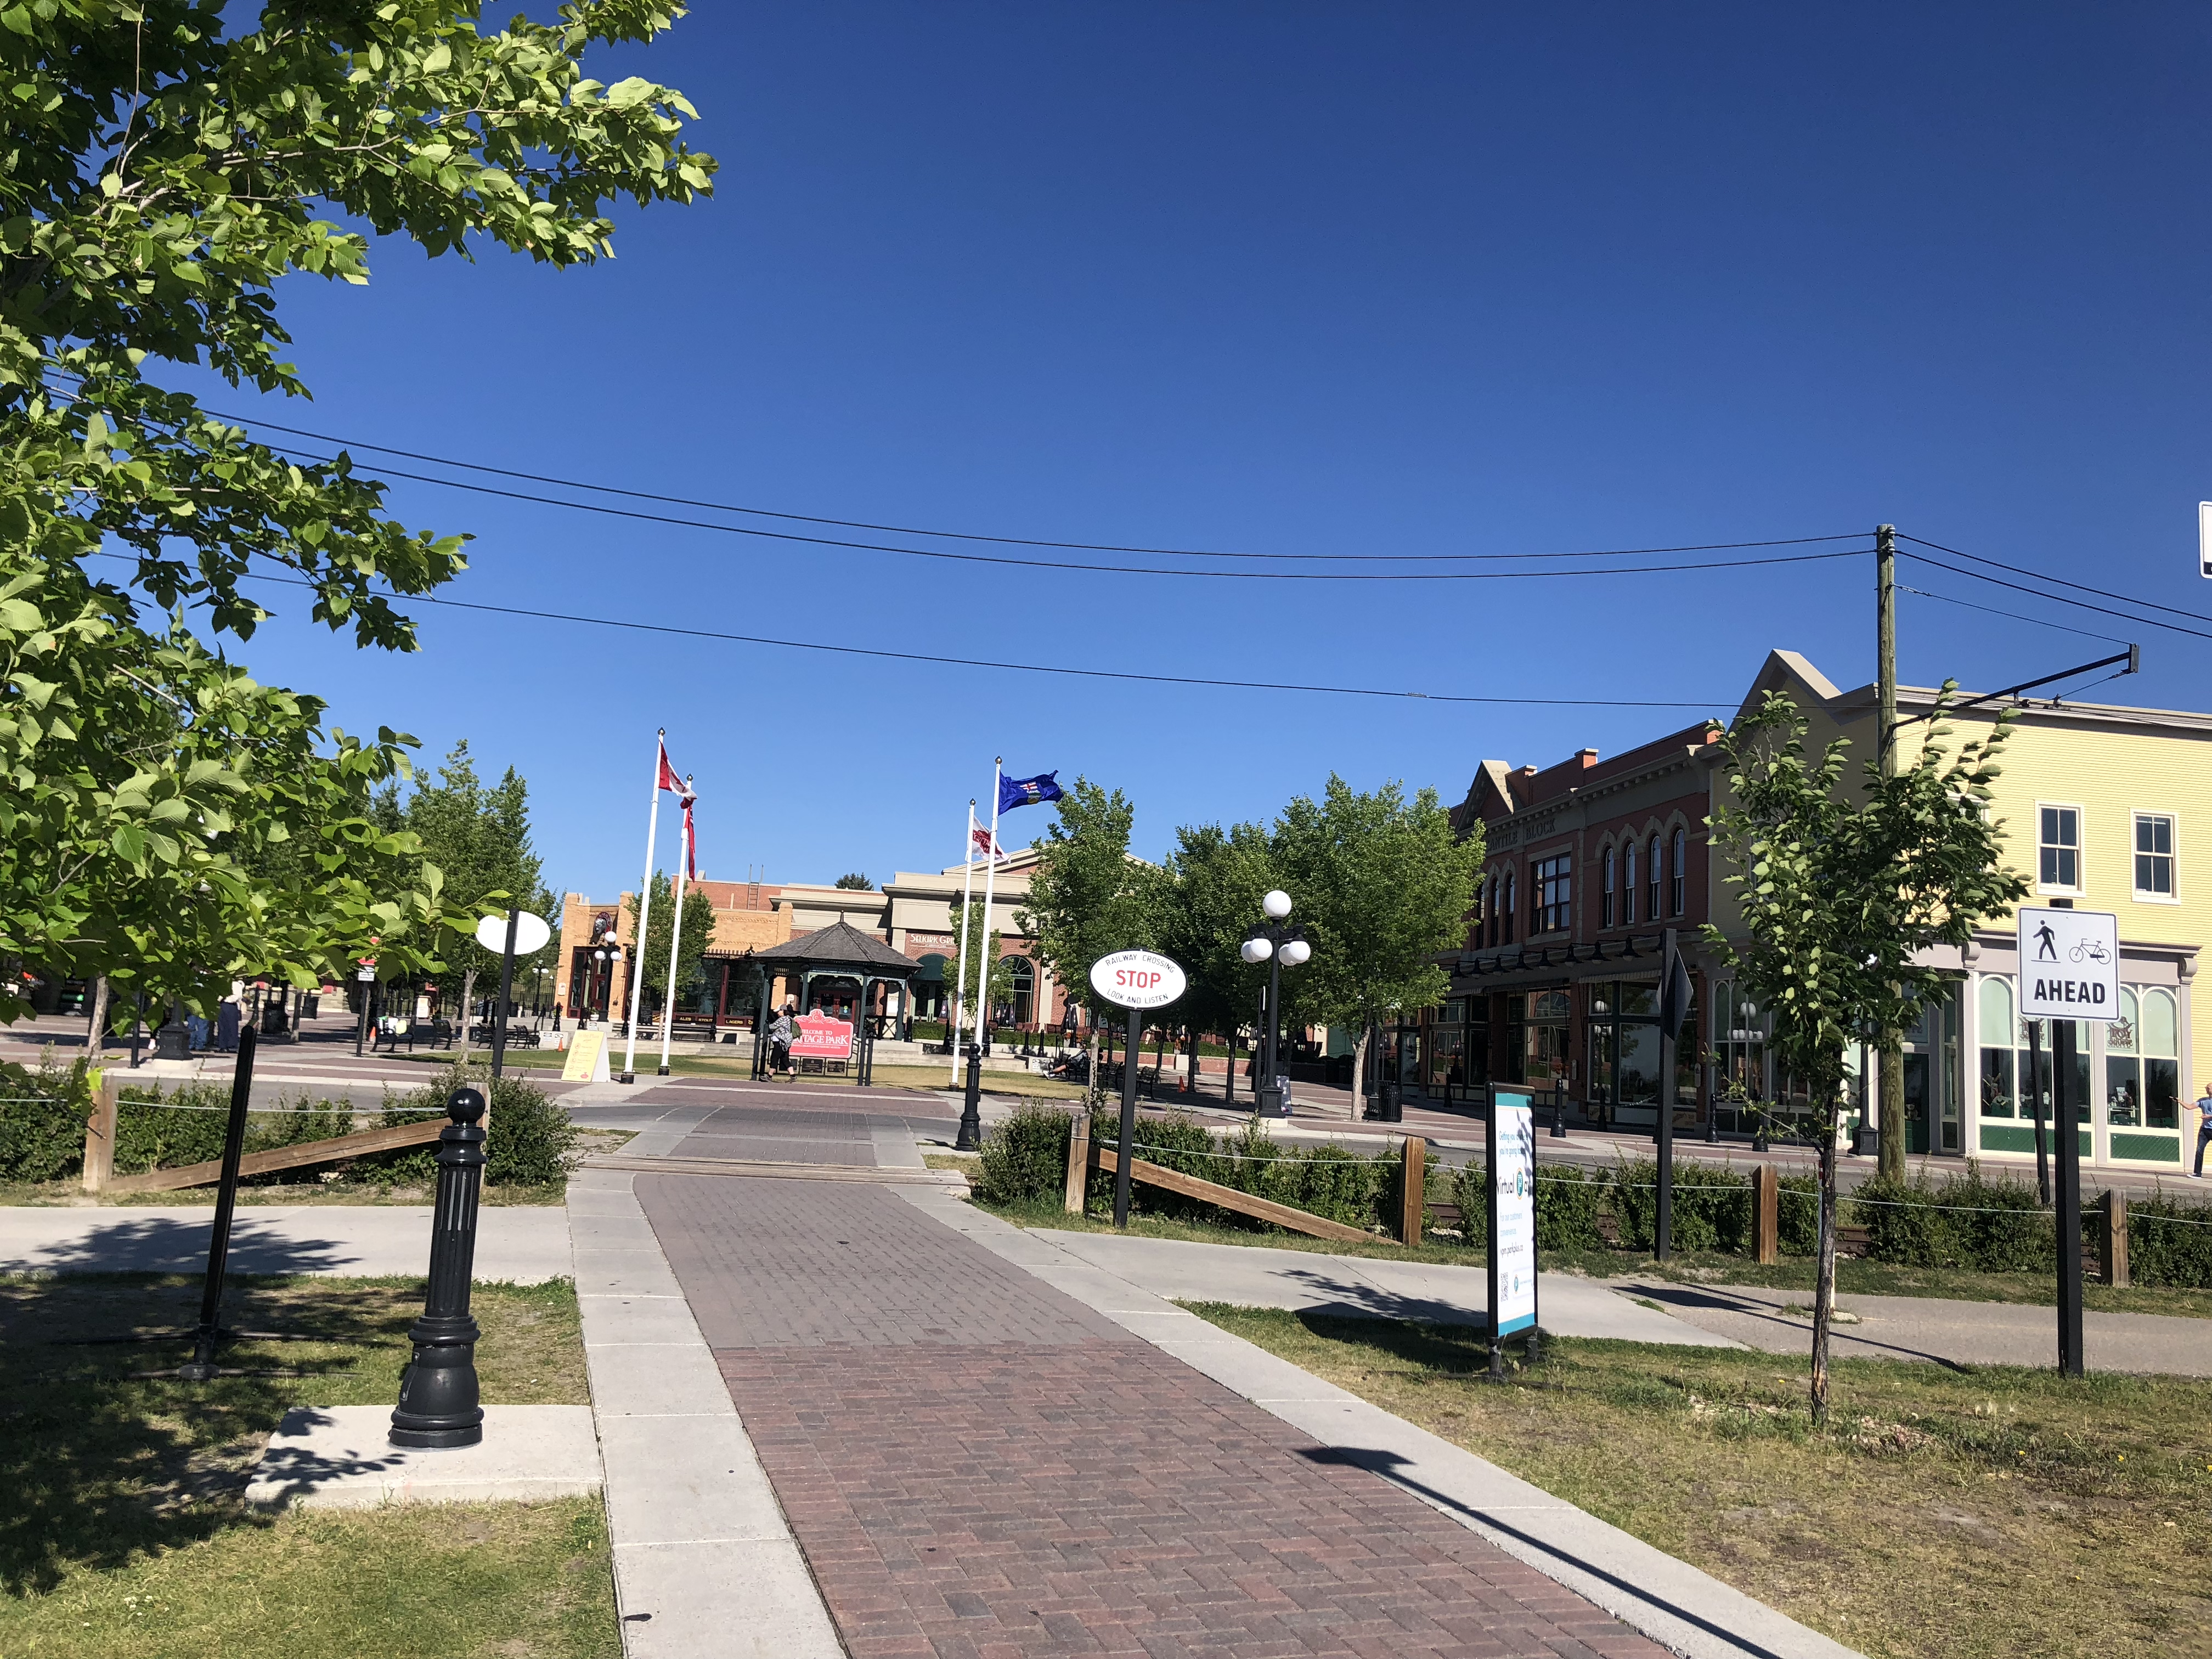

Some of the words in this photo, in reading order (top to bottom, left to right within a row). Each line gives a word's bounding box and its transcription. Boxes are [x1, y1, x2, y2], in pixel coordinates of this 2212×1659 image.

[1526, 818, 1556, 841] BLOCK
[910, 934, 939, 944] SELKIRK
[1105, 954, 1137, 967] RAILWAY
[1142, 955, 1175, 973] CROSSING
[1116, 969, 1161, 989] STOP
[1107, 988, 1125, 1001] LOOK
[1126, 996, 1141, 1004] AND
[1144, 993, 1169, 1004] LISTEN
[2034, 979, 2106, 1004] AHEAD
[826, 1035, 849, 1045] PARK
[1499, 1131, 1509, 1143] Getting
[1496, 1173, 1515, 1195] Virtual
